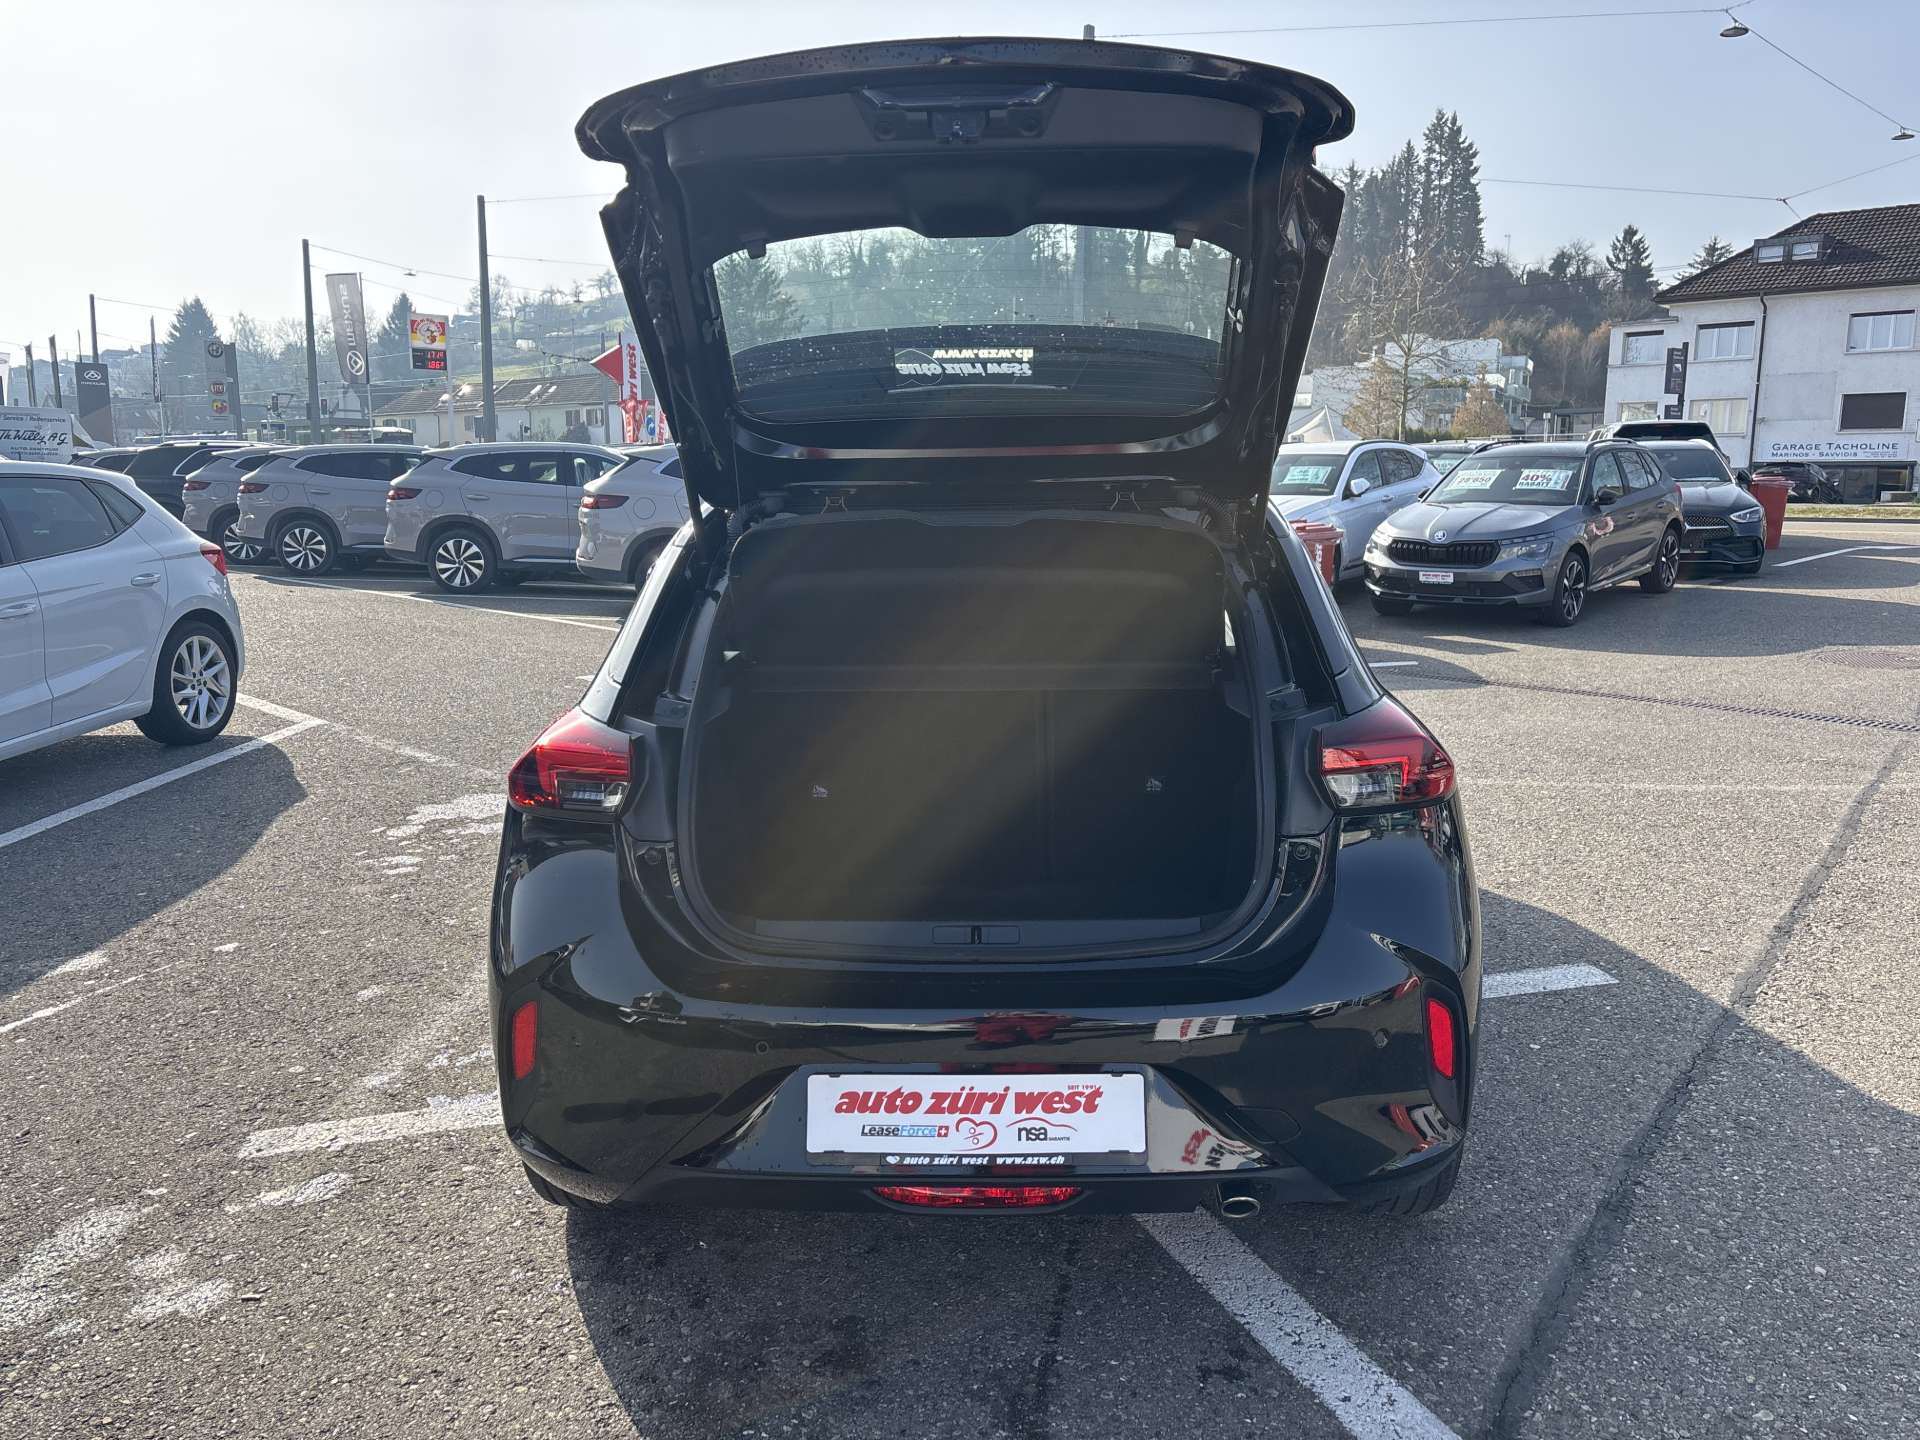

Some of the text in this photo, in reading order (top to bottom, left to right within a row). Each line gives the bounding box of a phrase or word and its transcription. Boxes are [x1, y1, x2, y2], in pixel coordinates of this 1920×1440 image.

[1772, 442, 1899, 451] GARAGE TACHOLINE
[1520, 474, 1552, 482] 40%
[834, 1086, 1104, 1114] auto züri west
[861, 1124, 937, 1137] LeaseForce
[1018, 1125, 1047, 1142] nsa
[903, 1155, 1065, 1165] auto züri west www.azw.ch
